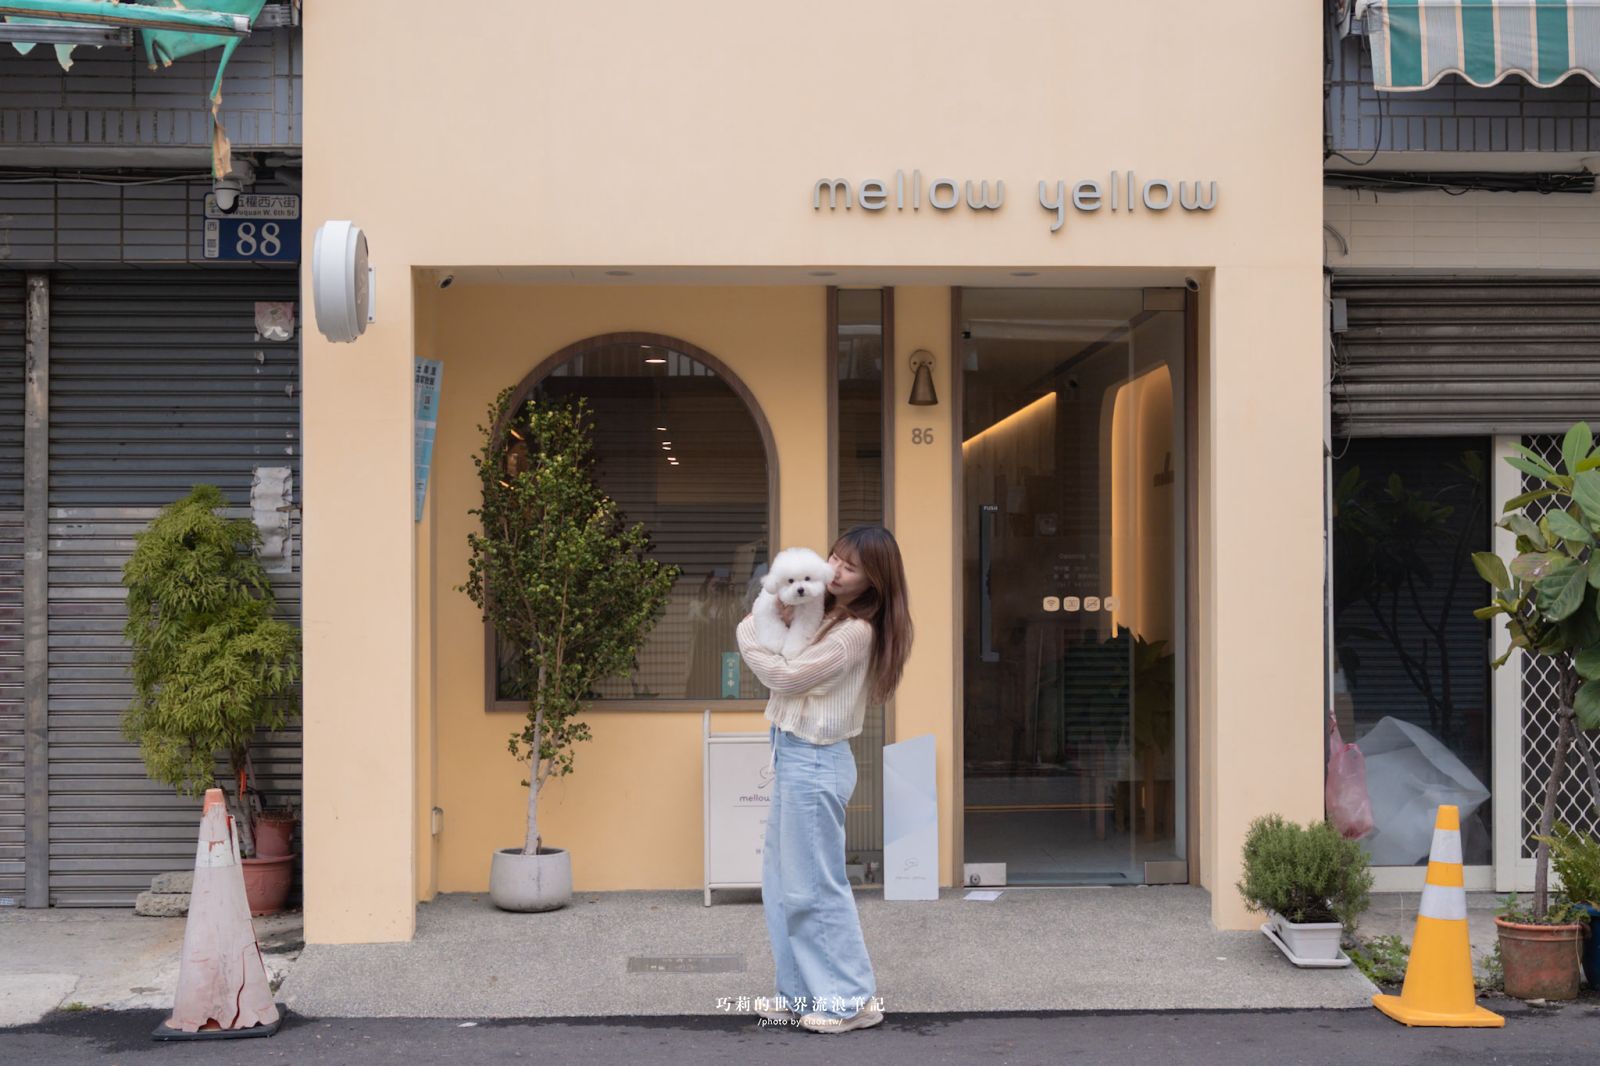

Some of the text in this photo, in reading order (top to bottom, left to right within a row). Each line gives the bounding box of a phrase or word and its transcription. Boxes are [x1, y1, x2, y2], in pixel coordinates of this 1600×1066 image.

[813, 168, 1218, 233] mellow yellow
[236, 222, 281, 257] 88
[911, 427, 934, 445] 86
